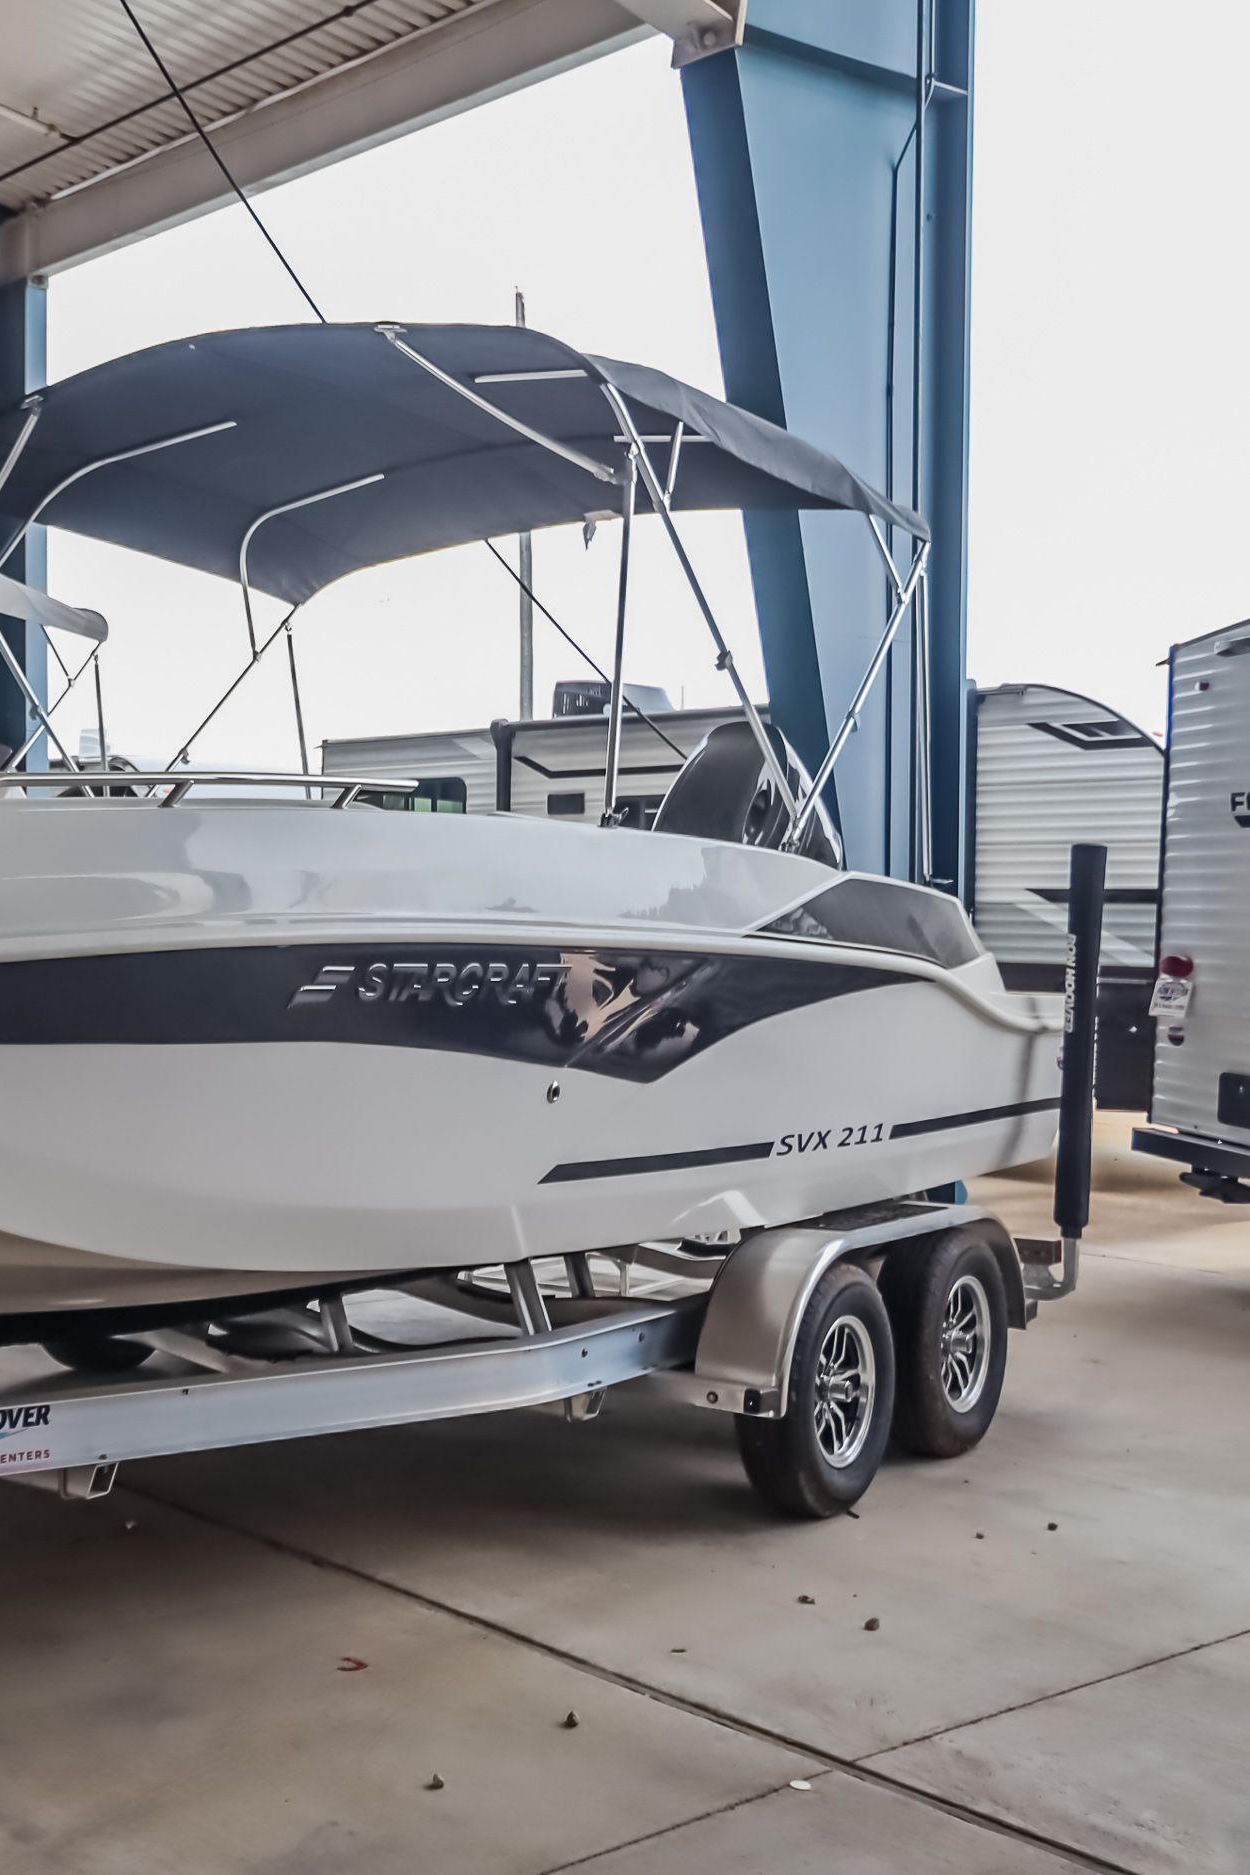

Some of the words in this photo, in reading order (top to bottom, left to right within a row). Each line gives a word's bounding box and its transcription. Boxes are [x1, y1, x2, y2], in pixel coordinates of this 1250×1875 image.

[358, 963, 572, 1006] STARCRAFT
[776, 1129, 832, 1156] SVX
[837, 1122, 884, 1147] 211
